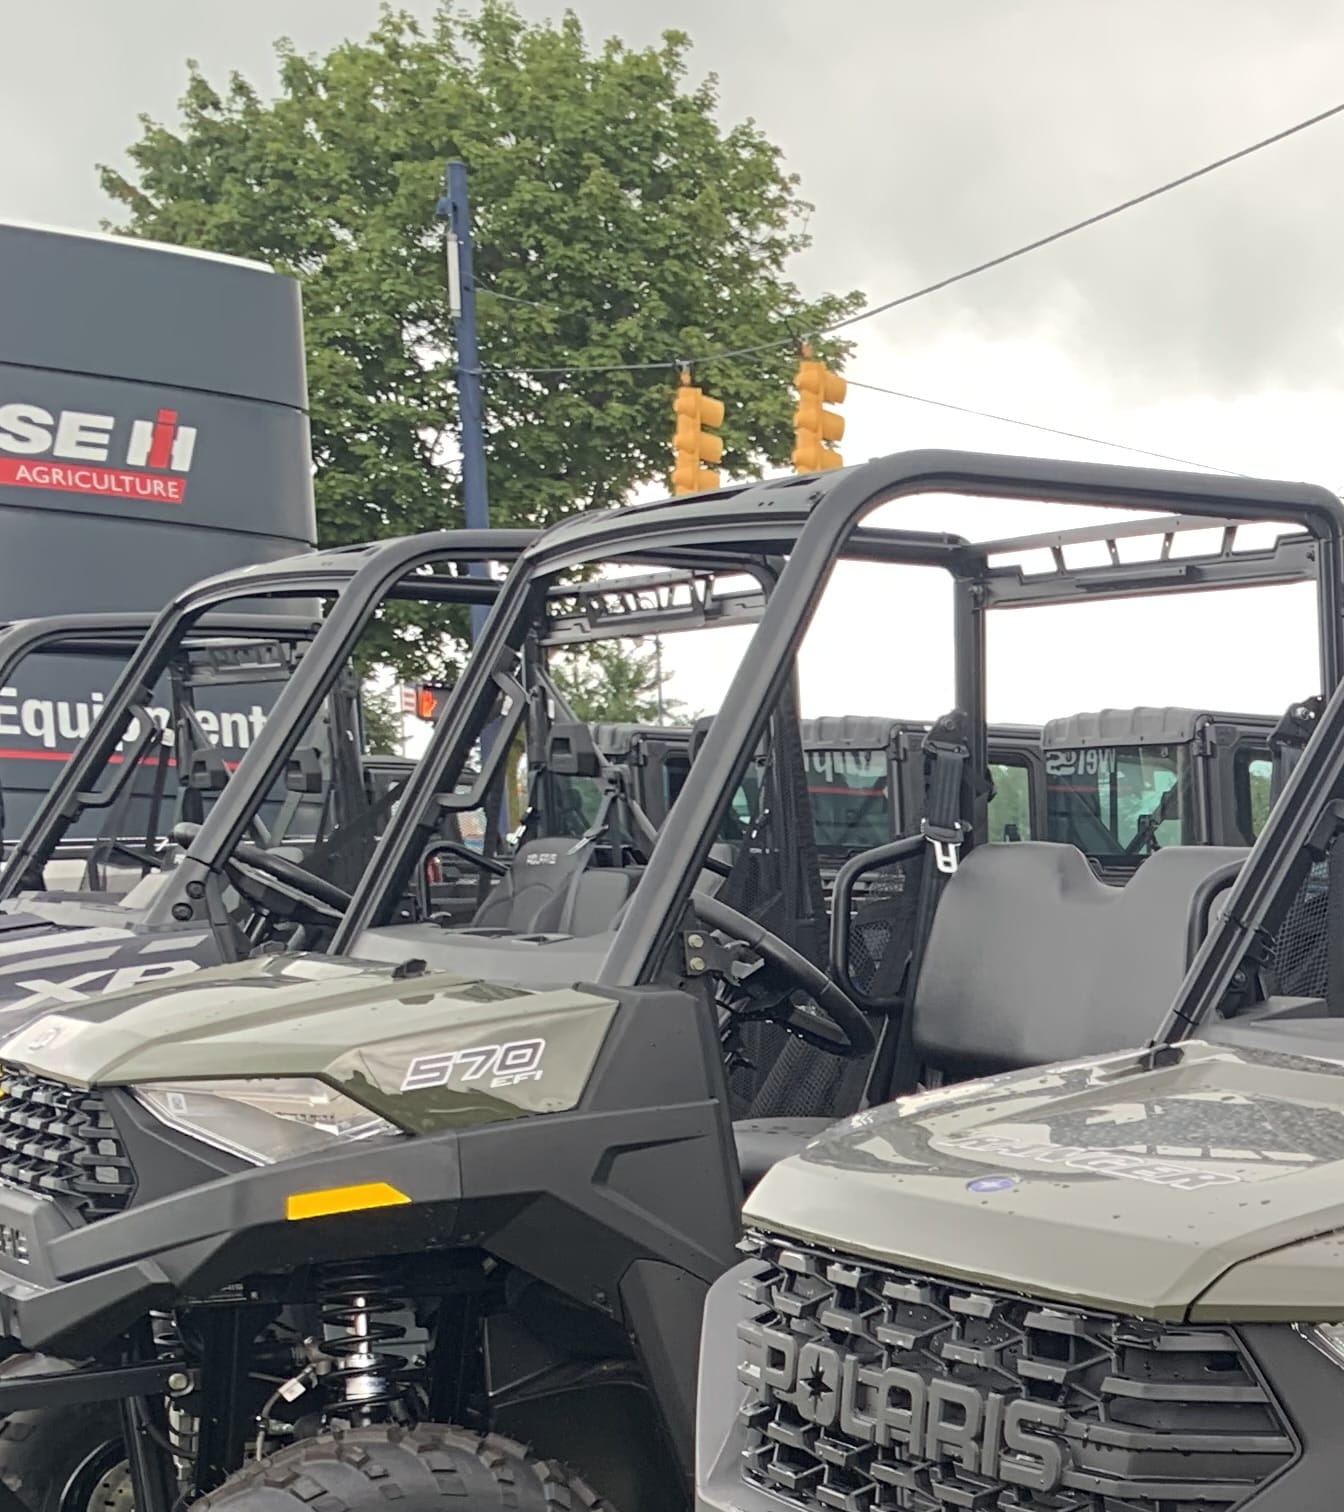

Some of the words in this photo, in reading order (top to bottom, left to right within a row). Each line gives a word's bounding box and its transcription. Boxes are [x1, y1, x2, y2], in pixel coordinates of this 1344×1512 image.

[15, 464, 180, 500] AGRICULTURE
[400, 1037, 546, 1092] 570
[490, 1070, 543, 1089] EFI
[761, 1326, 1070, 1493] POLARIS
